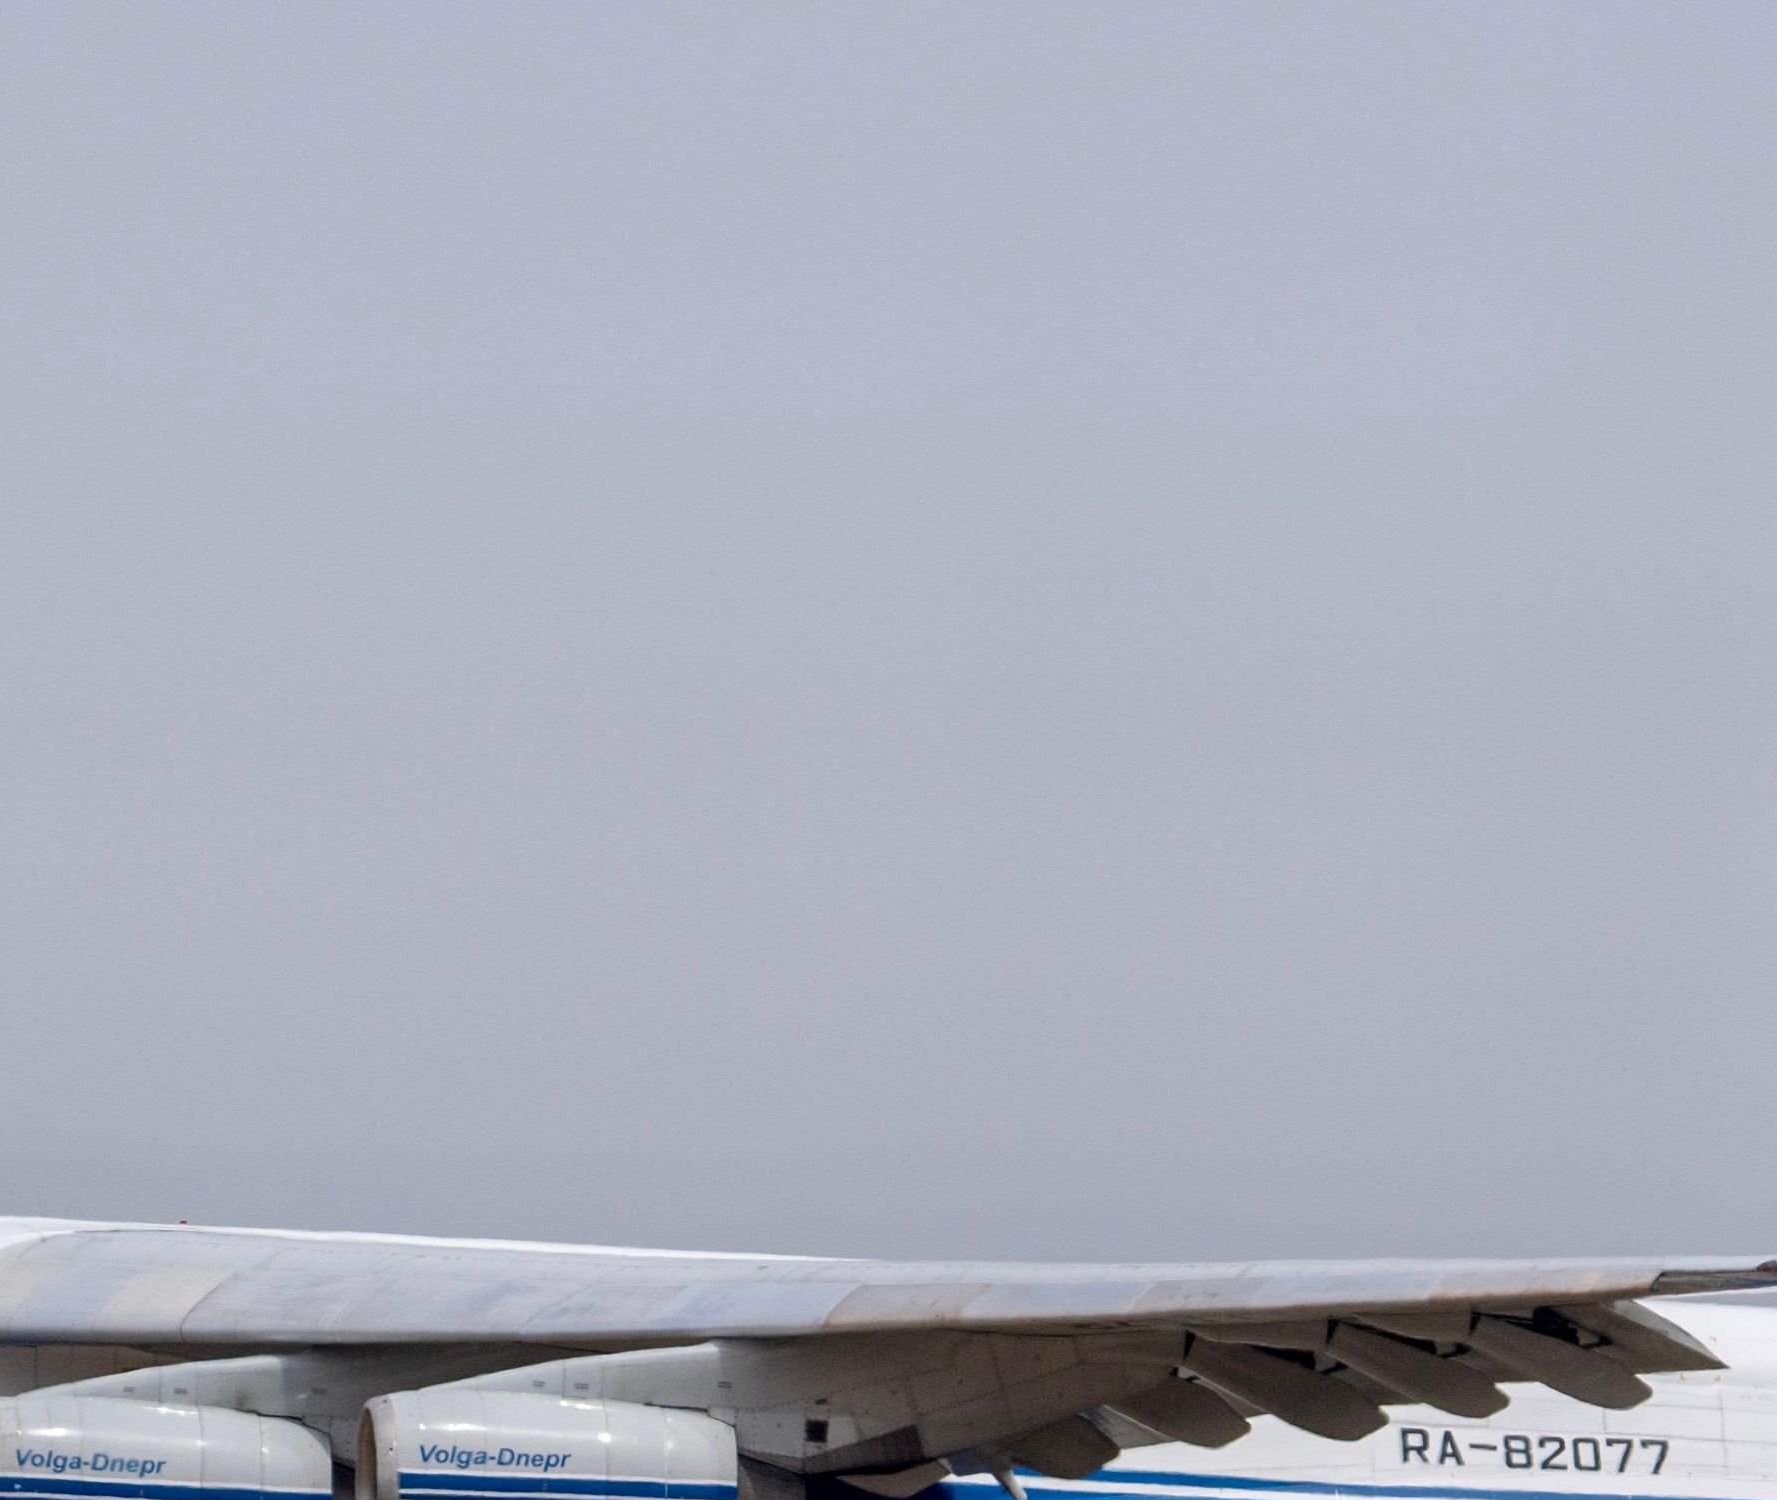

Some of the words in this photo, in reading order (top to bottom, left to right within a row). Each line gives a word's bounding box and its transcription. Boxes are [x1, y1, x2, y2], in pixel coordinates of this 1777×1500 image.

[15, 1448, 168, 1478] Volga-Dnepr
[418, 1444, 572, 1472] Volga-Dnepr
[1400, 1427, 1671, 1476] RA-82077
